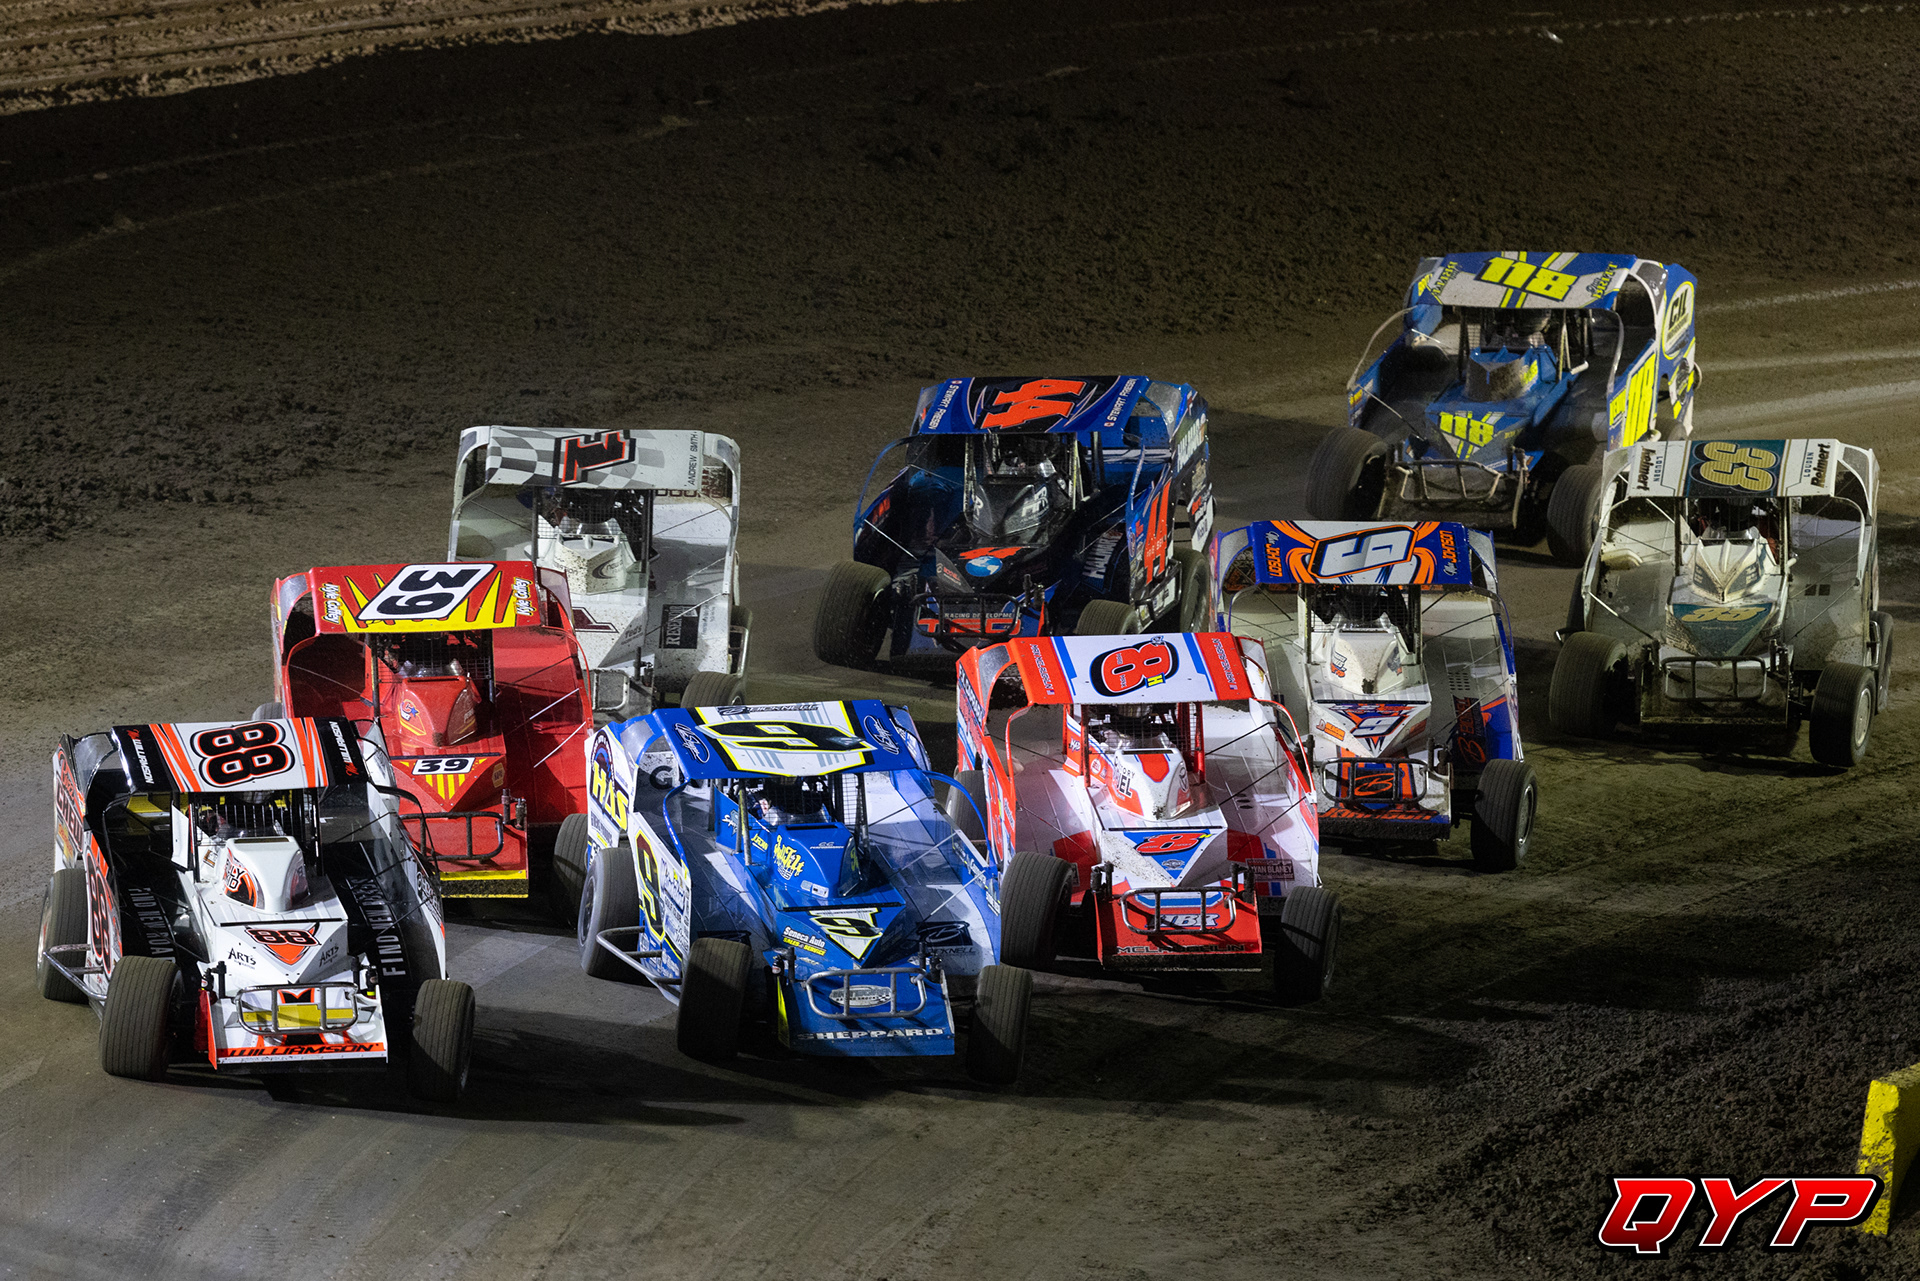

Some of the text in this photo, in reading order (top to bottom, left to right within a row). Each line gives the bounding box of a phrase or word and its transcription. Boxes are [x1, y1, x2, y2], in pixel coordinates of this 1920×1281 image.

[1476, 256, 1579, 302] 118
[1592, 261, 1618, 299] BRITT
[928, 385, 960, 430] STEWART FRIESEN
[981, 378, 1086, 429] 44
[1112, 377, 1138, 421] STEWART FRIESEN
[1440, 411, 1495, 448] 118
[687, 432, 698, 486] ANDREW SMITH
[1653, 455, 1664, 482] LOUDEN
[1697, 441, 1780, 492] 33
[1803, 451, 1815, 478] LOUDEN
[1810, 443, 1831, 488] Reimert
[1264, 543, 1284, 578] JOHNSON
[1316, 528, 1415, 578] 9
[1438, 530, 1456, 564] JOHNSON
[320, 582, 341, 625] Kyle Coffey
[376, 568, 482, 615] 39
[512, 577, 536, 617] Kyle Coffey
[1093, 642, 1179, 697] 8
[329, 720, 353, 764] WILLIAMSON
[702, 720, 873, 752] 9
[1350, 715, 1402, 738] 9
[132, 738, 154, 784] WILLIAMSON
[193, 721, 293, 786] 88
[418, 758, 470, 773] 39
[1133, 832, 1203, 855] 8
[244, 929, 322, 946] 88
[783, 925, 827, 949] Seneca Auto
[810, 916, 884, 939] 9
[375, 934, 407, 977] FIND
[228, 1043, 375, 1057] WILLIAMSON
[798, 1027, 946, 1040] SHEPPARD
